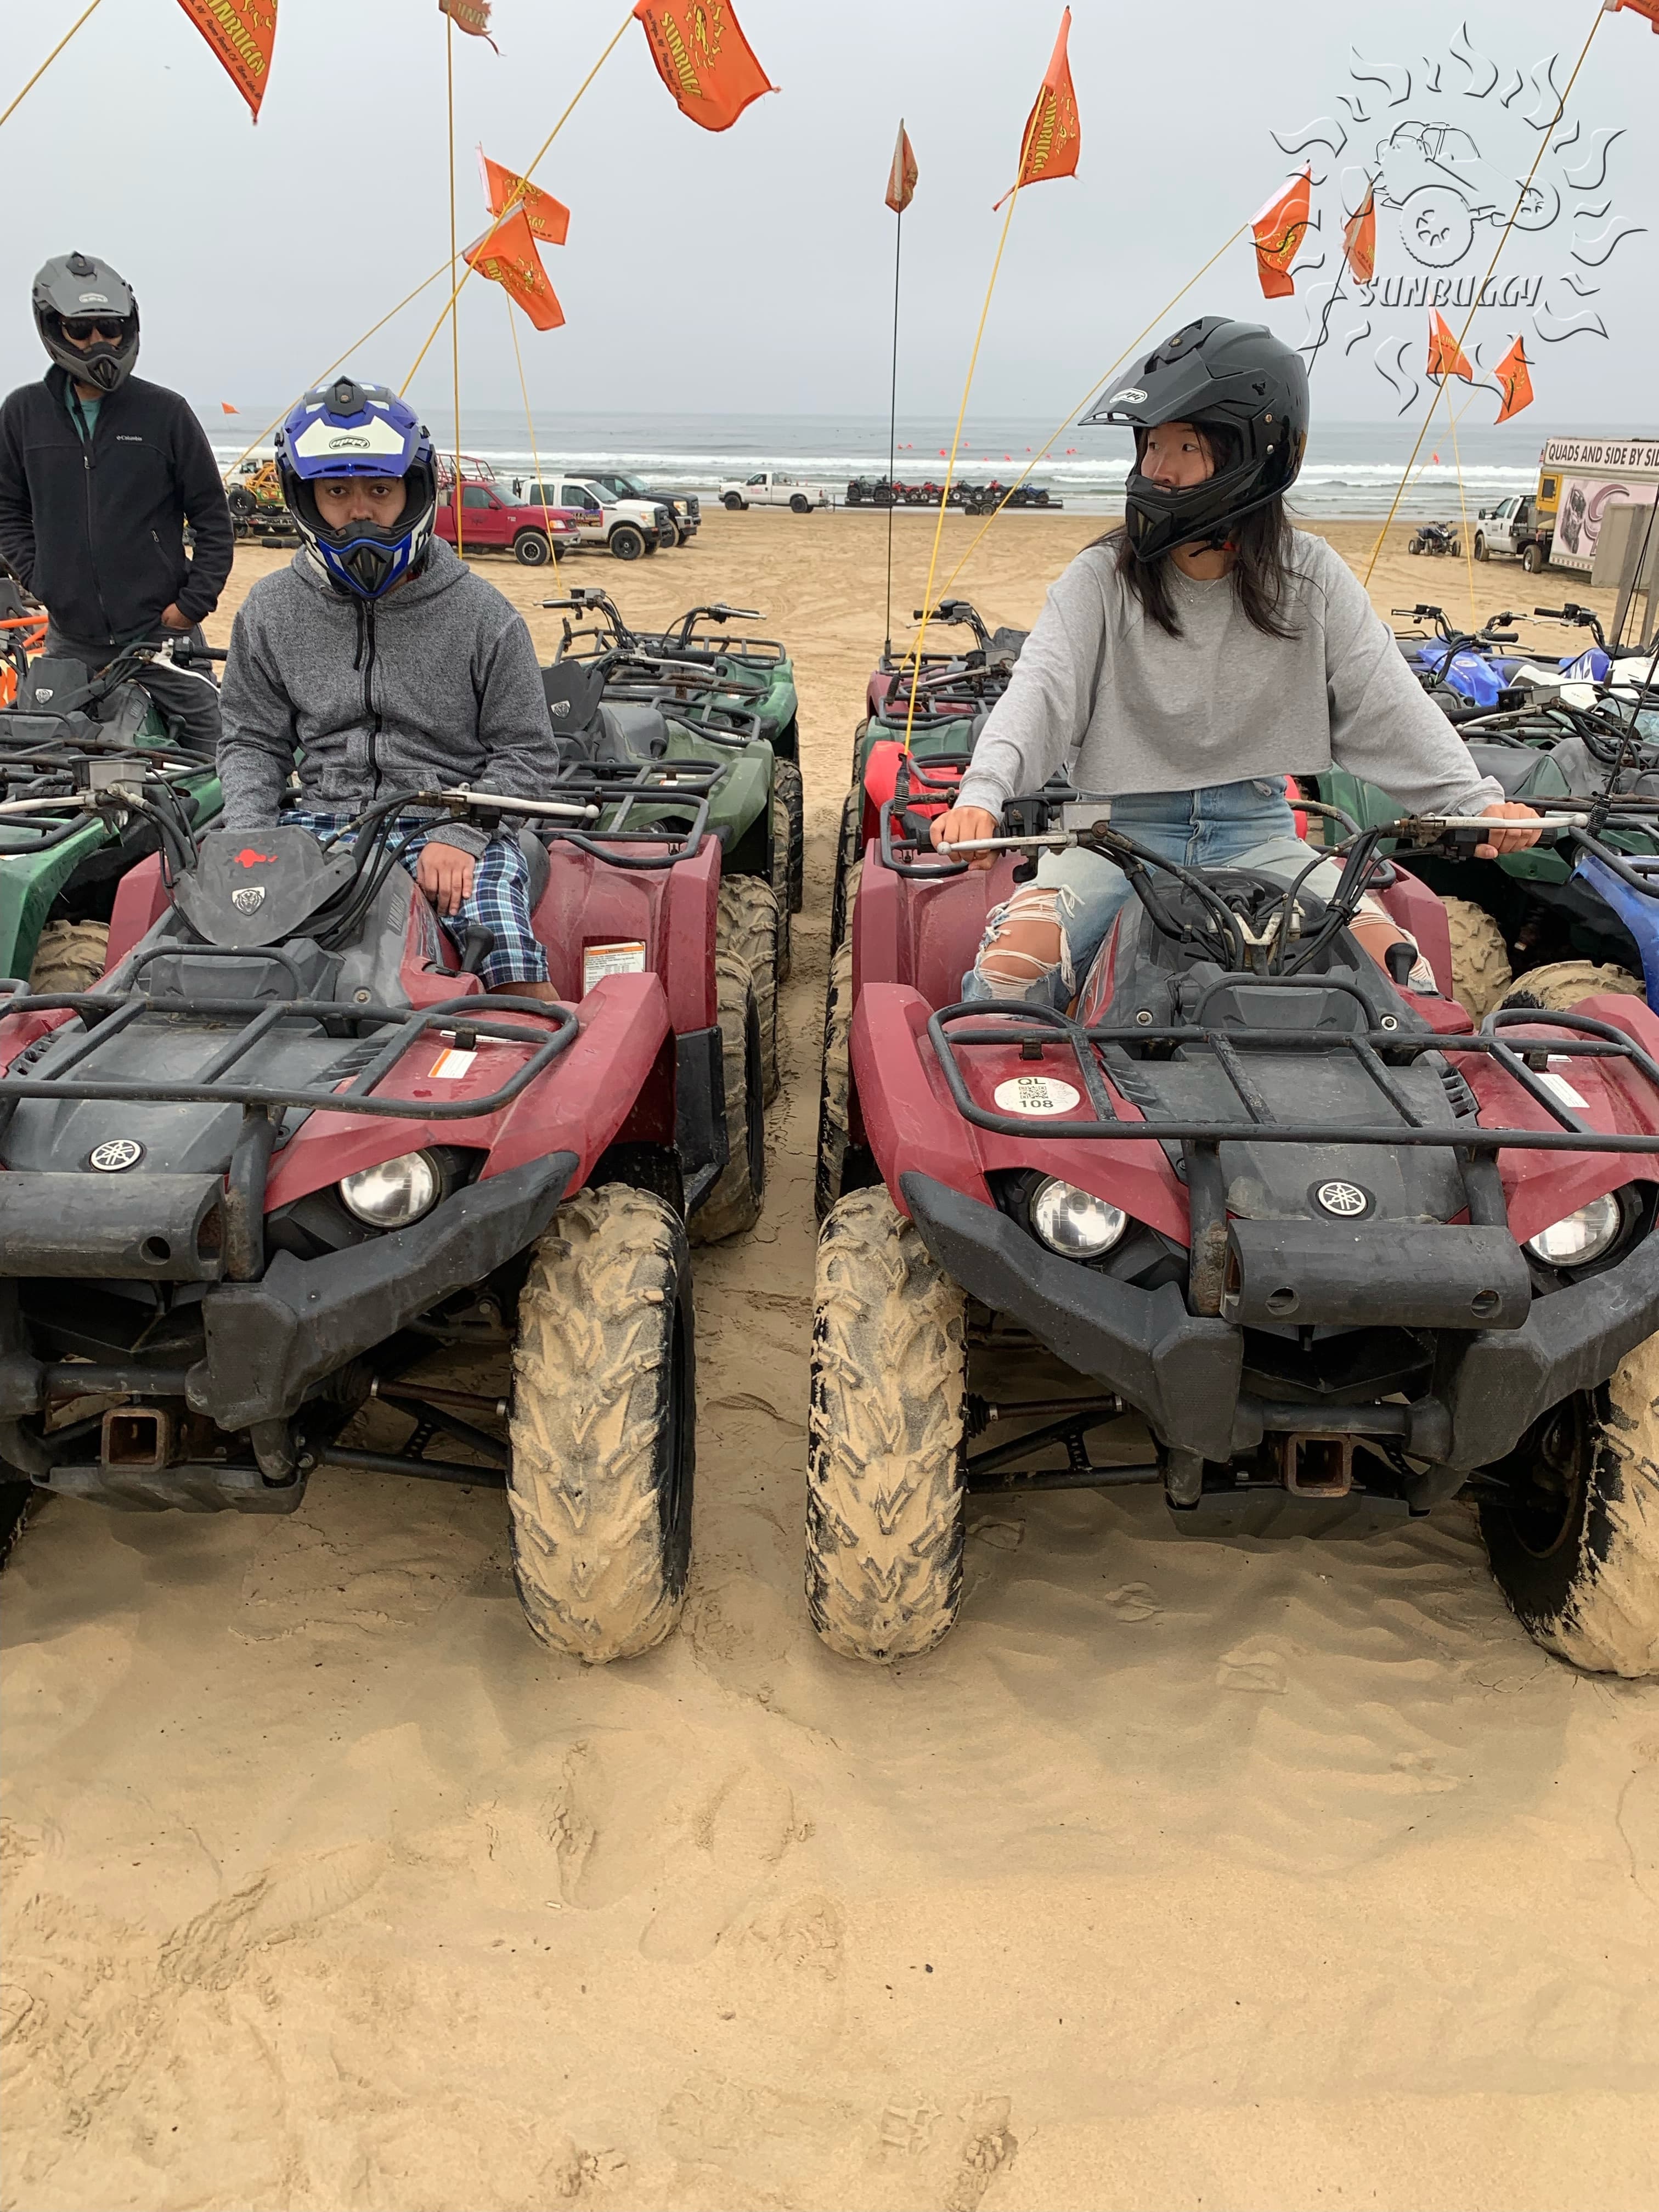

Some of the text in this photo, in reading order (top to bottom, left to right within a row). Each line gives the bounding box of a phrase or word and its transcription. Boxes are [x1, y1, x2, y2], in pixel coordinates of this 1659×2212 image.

[1549, 444, 1580, 461] QUADS
[1581, 446, 1602, 464] AND
[1604, 447, 1627, 465] SIDE
[1628, 448, 1644, 465] BY
